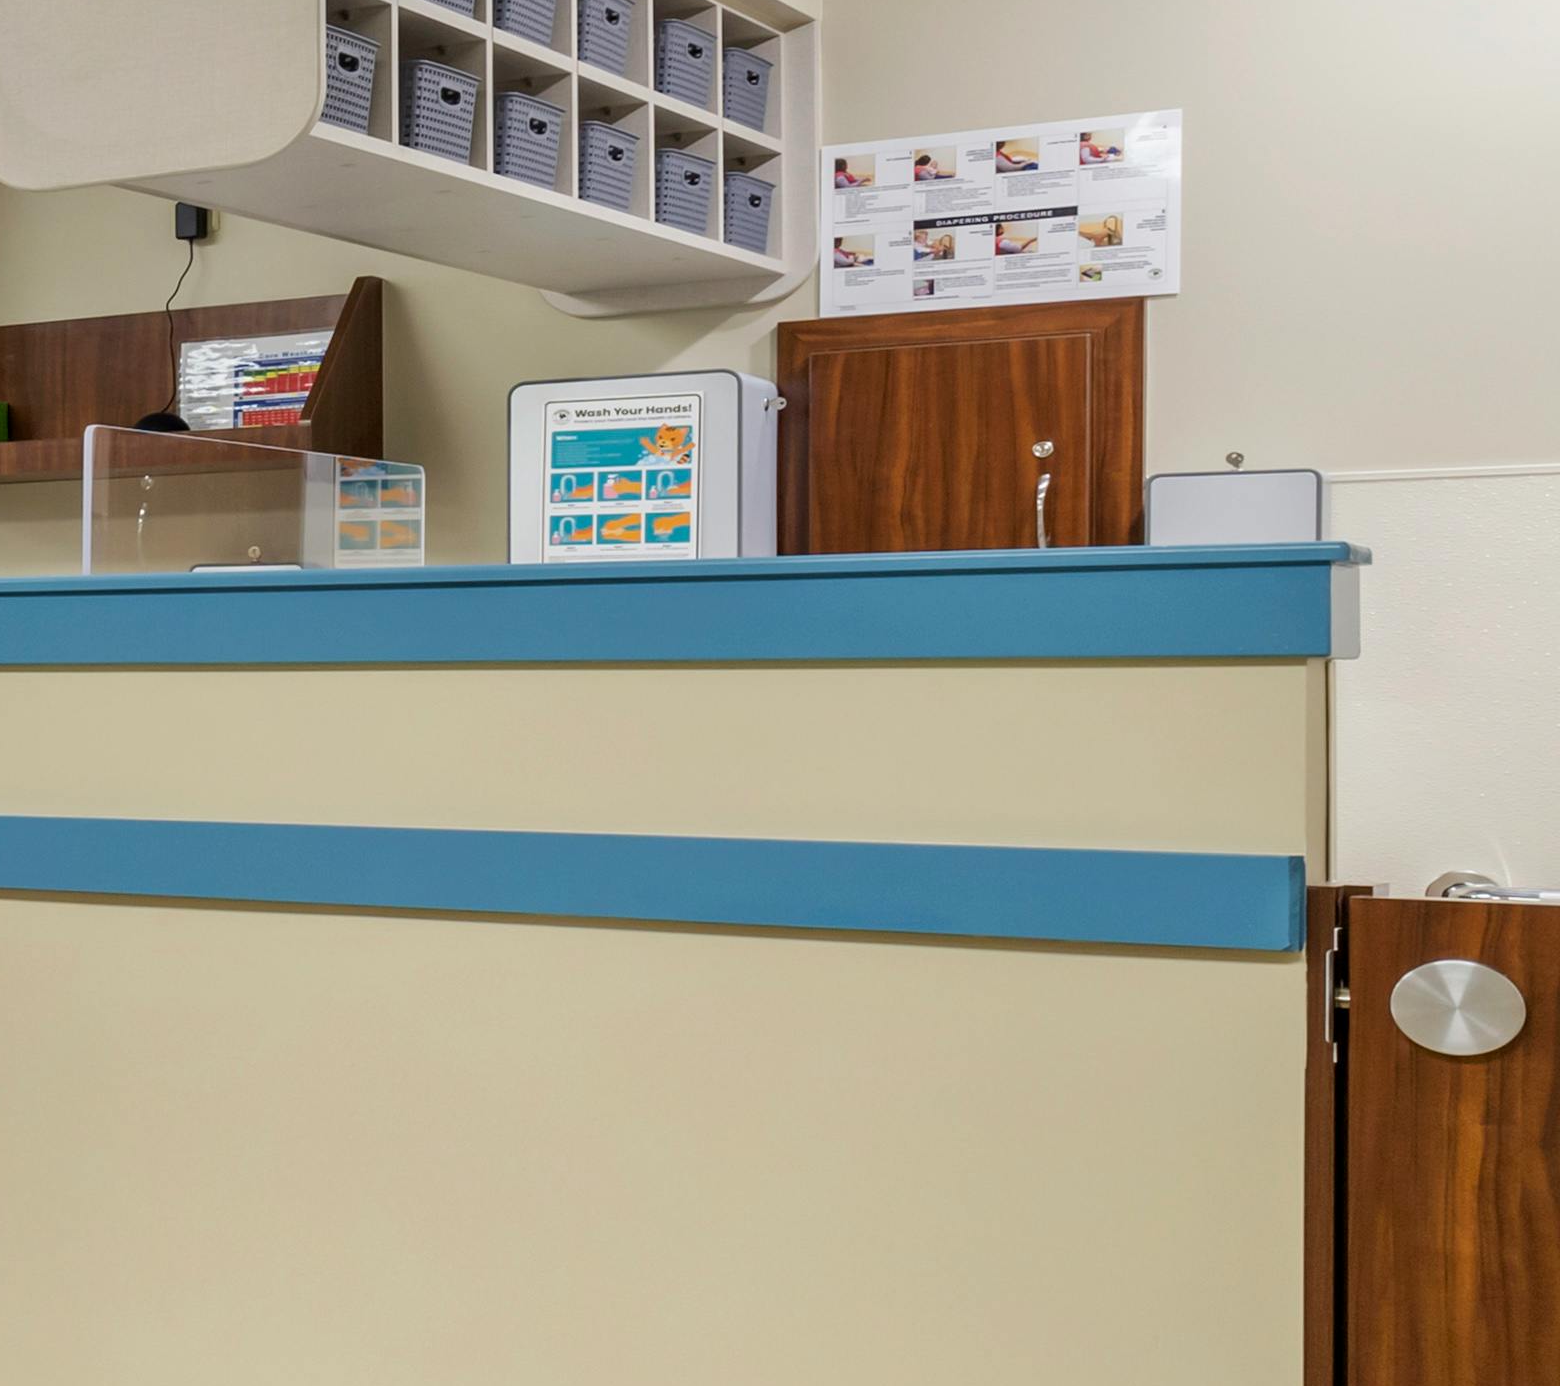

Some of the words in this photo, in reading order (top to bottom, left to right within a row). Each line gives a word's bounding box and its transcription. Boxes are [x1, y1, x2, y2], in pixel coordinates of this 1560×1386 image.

[935, 215, 990, 227] DIAPERING
[993, 210, 1054, 222] PROCEDURE
[574, 408, 611, 418] Wash
[614, 406, 642, 416] Your
[646, 403, 692, 414] Hands!
